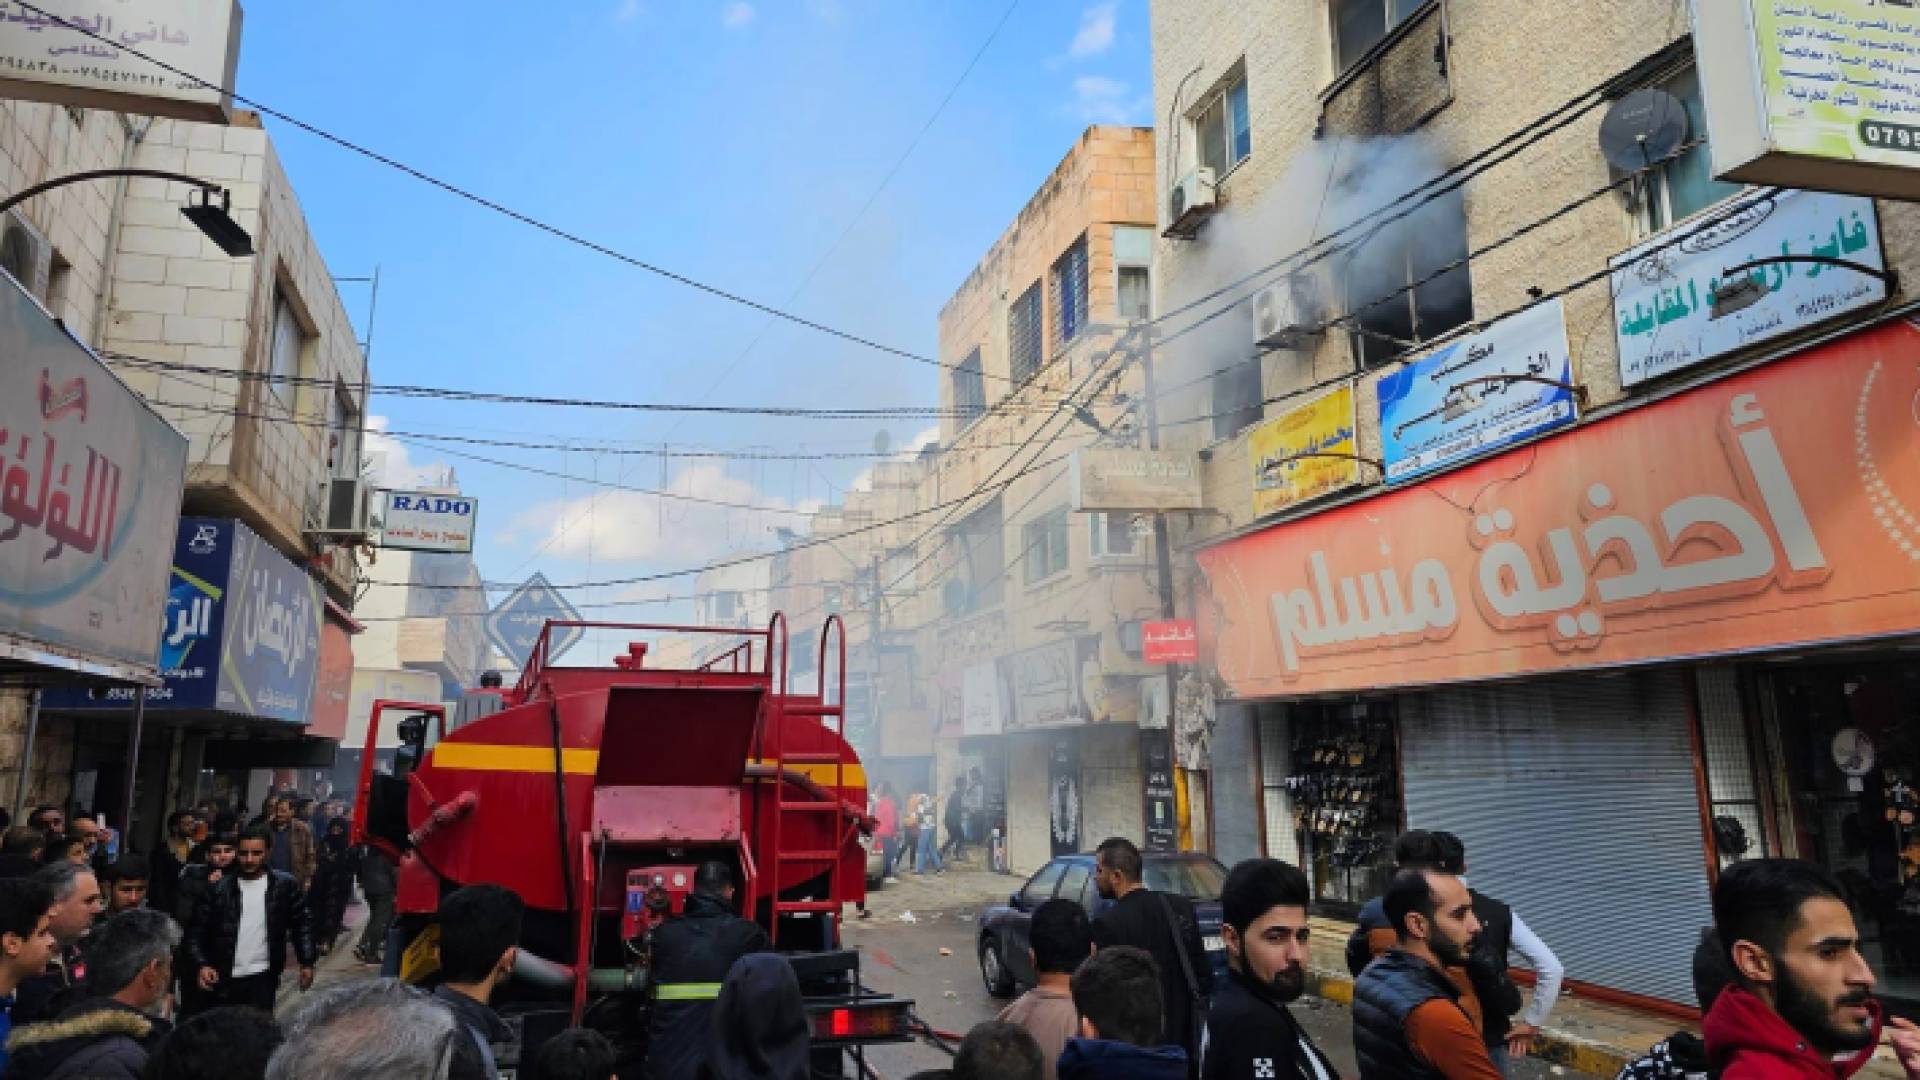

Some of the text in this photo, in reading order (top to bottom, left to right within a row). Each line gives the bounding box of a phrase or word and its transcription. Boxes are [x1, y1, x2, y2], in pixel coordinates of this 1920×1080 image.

[1620, 277, 1698, 338] المقابلة
[392, 496, 470, 516] RADO
[1478, 396, 1828, 639] أحذية
